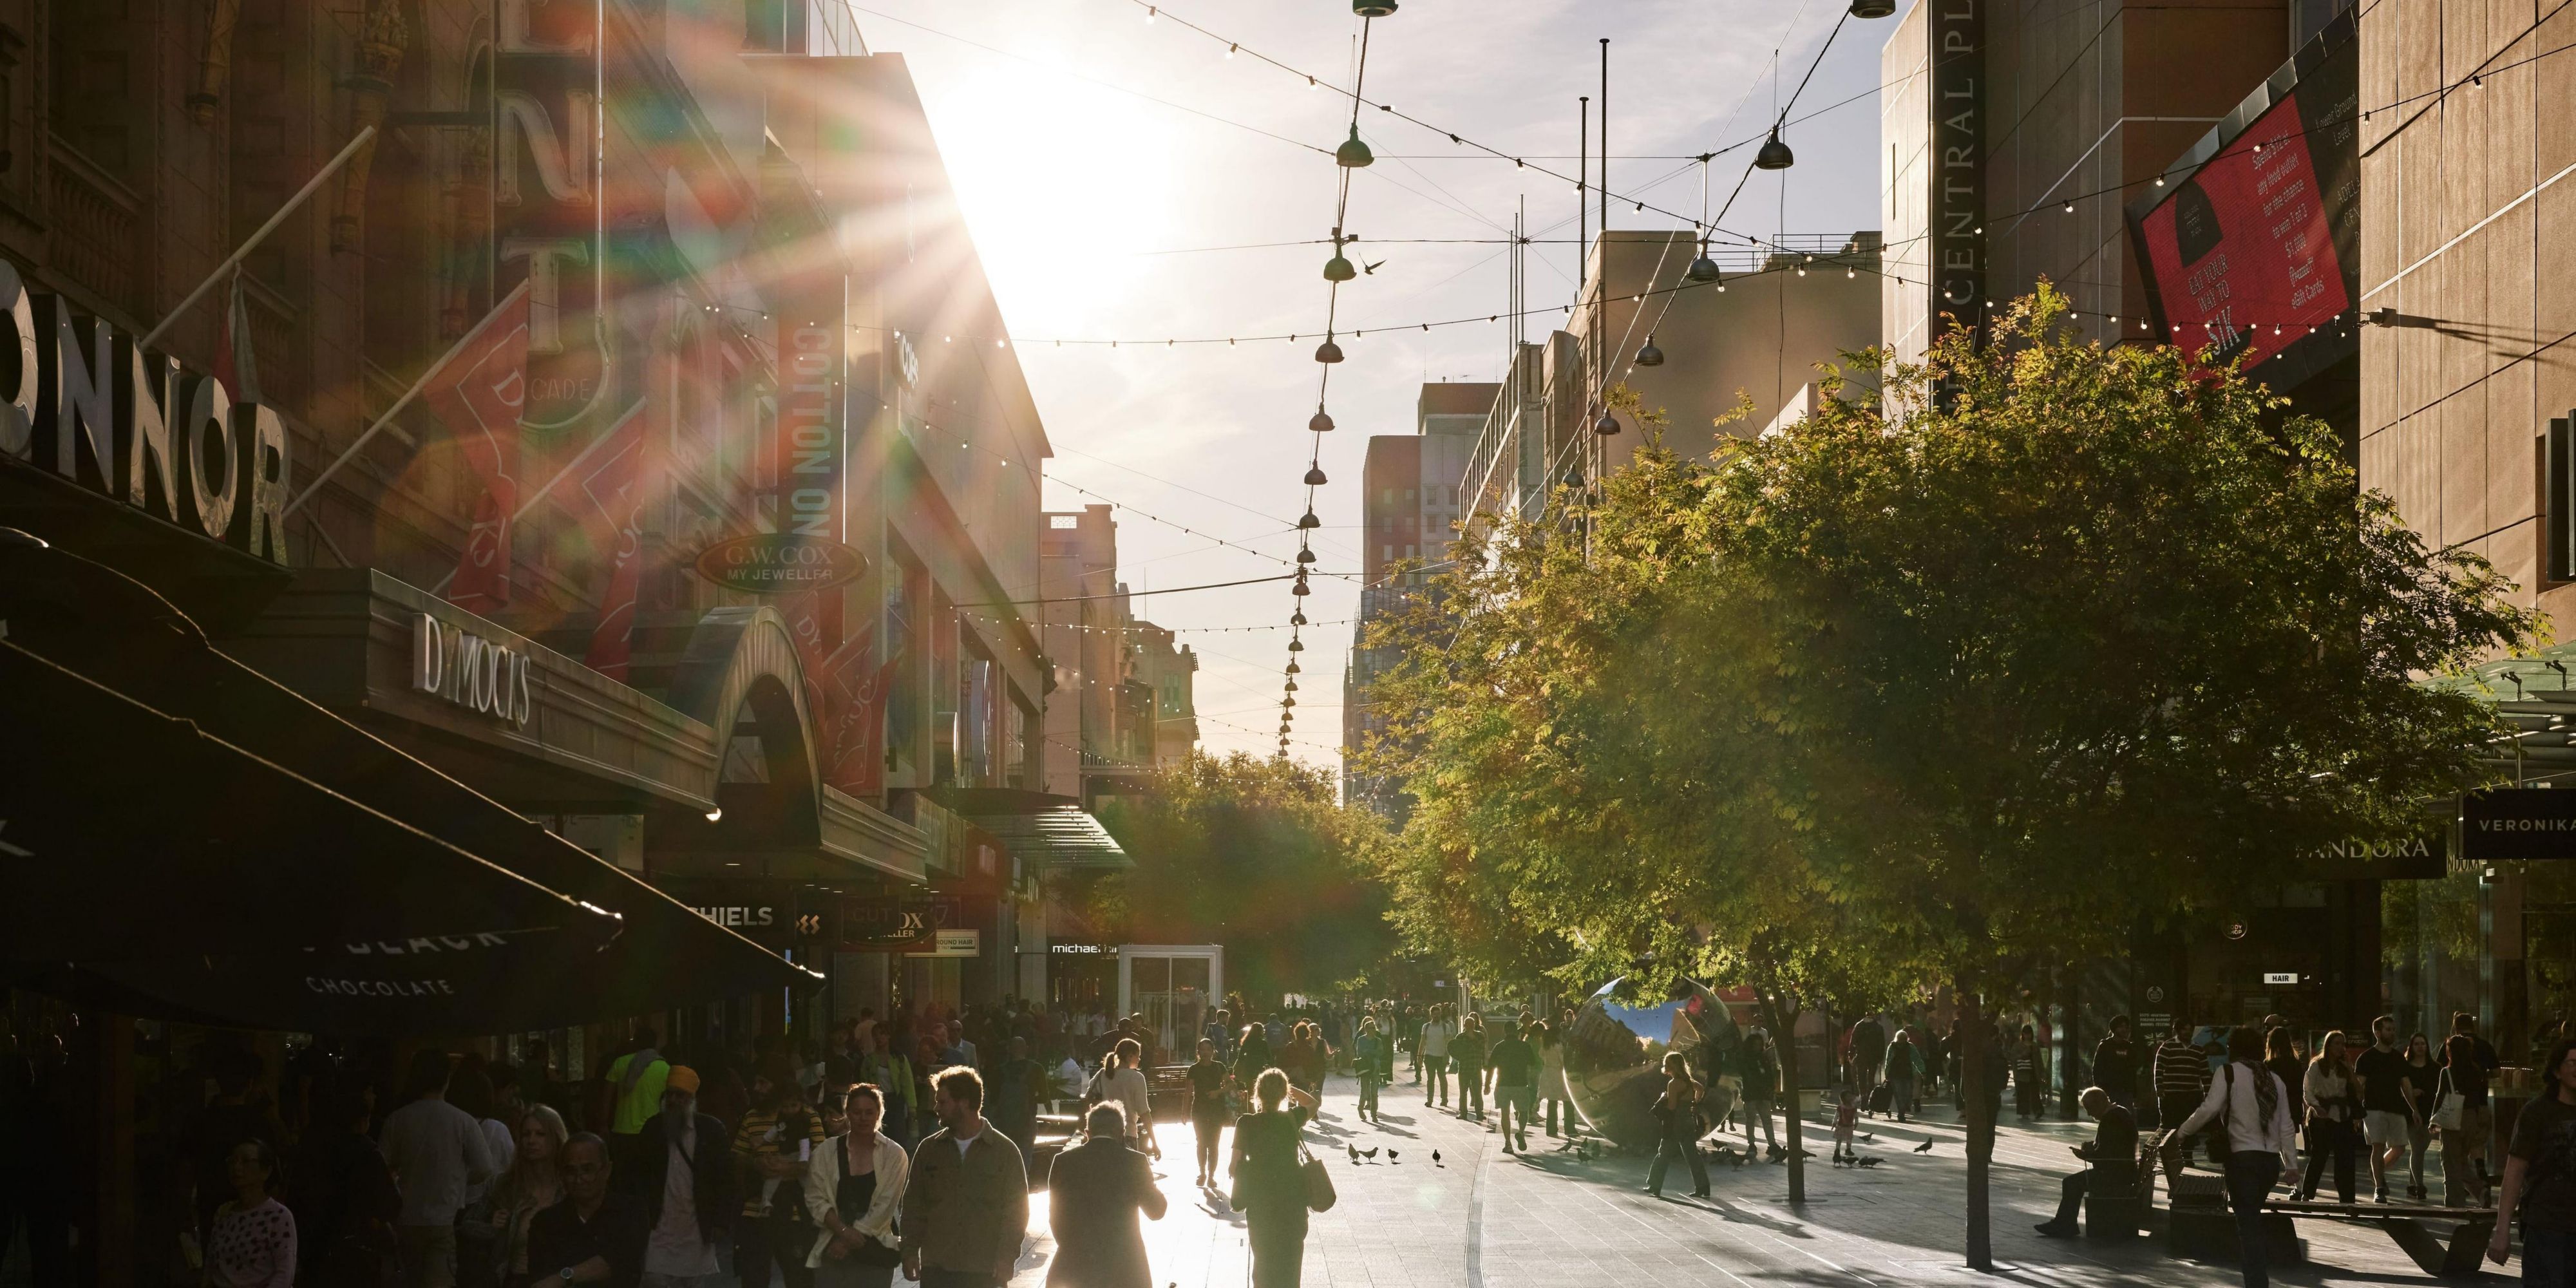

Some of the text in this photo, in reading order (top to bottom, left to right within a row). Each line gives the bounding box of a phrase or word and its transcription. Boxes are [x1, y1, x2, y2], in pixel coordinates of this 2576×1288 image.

[2315, 89, 2357, 133] Lower Ground
[2333, 122, 2351, 146] Level
[2252, 144, 2271, 171] Spend
[2257, 153, 2299, 195] any food outlet
[1944, 77, 1974, 305] CENTRAL
[2263, 179, 2305, 217] for the chance
[2272, 226, 2280, 239] to
[2279, 218, 2291, 234] win
[2295, 205, 2303, 222] of
[2300, 202, 2307, 218] 3
[2284, 231, 2306, 260] $1,000
[2188, 254, 2229, 296] EAT YOUR
[2197, 279, 2230, 314] WAY TO
[2291, 289, 2307, 310] eGift
[790, 328, 833, 537] COTTON ON
[779, 546, 834, 564] COX
[728, 569, 833, 580] MY JEWELLER
[305, 976, 455, 996] CHOCOLATE
